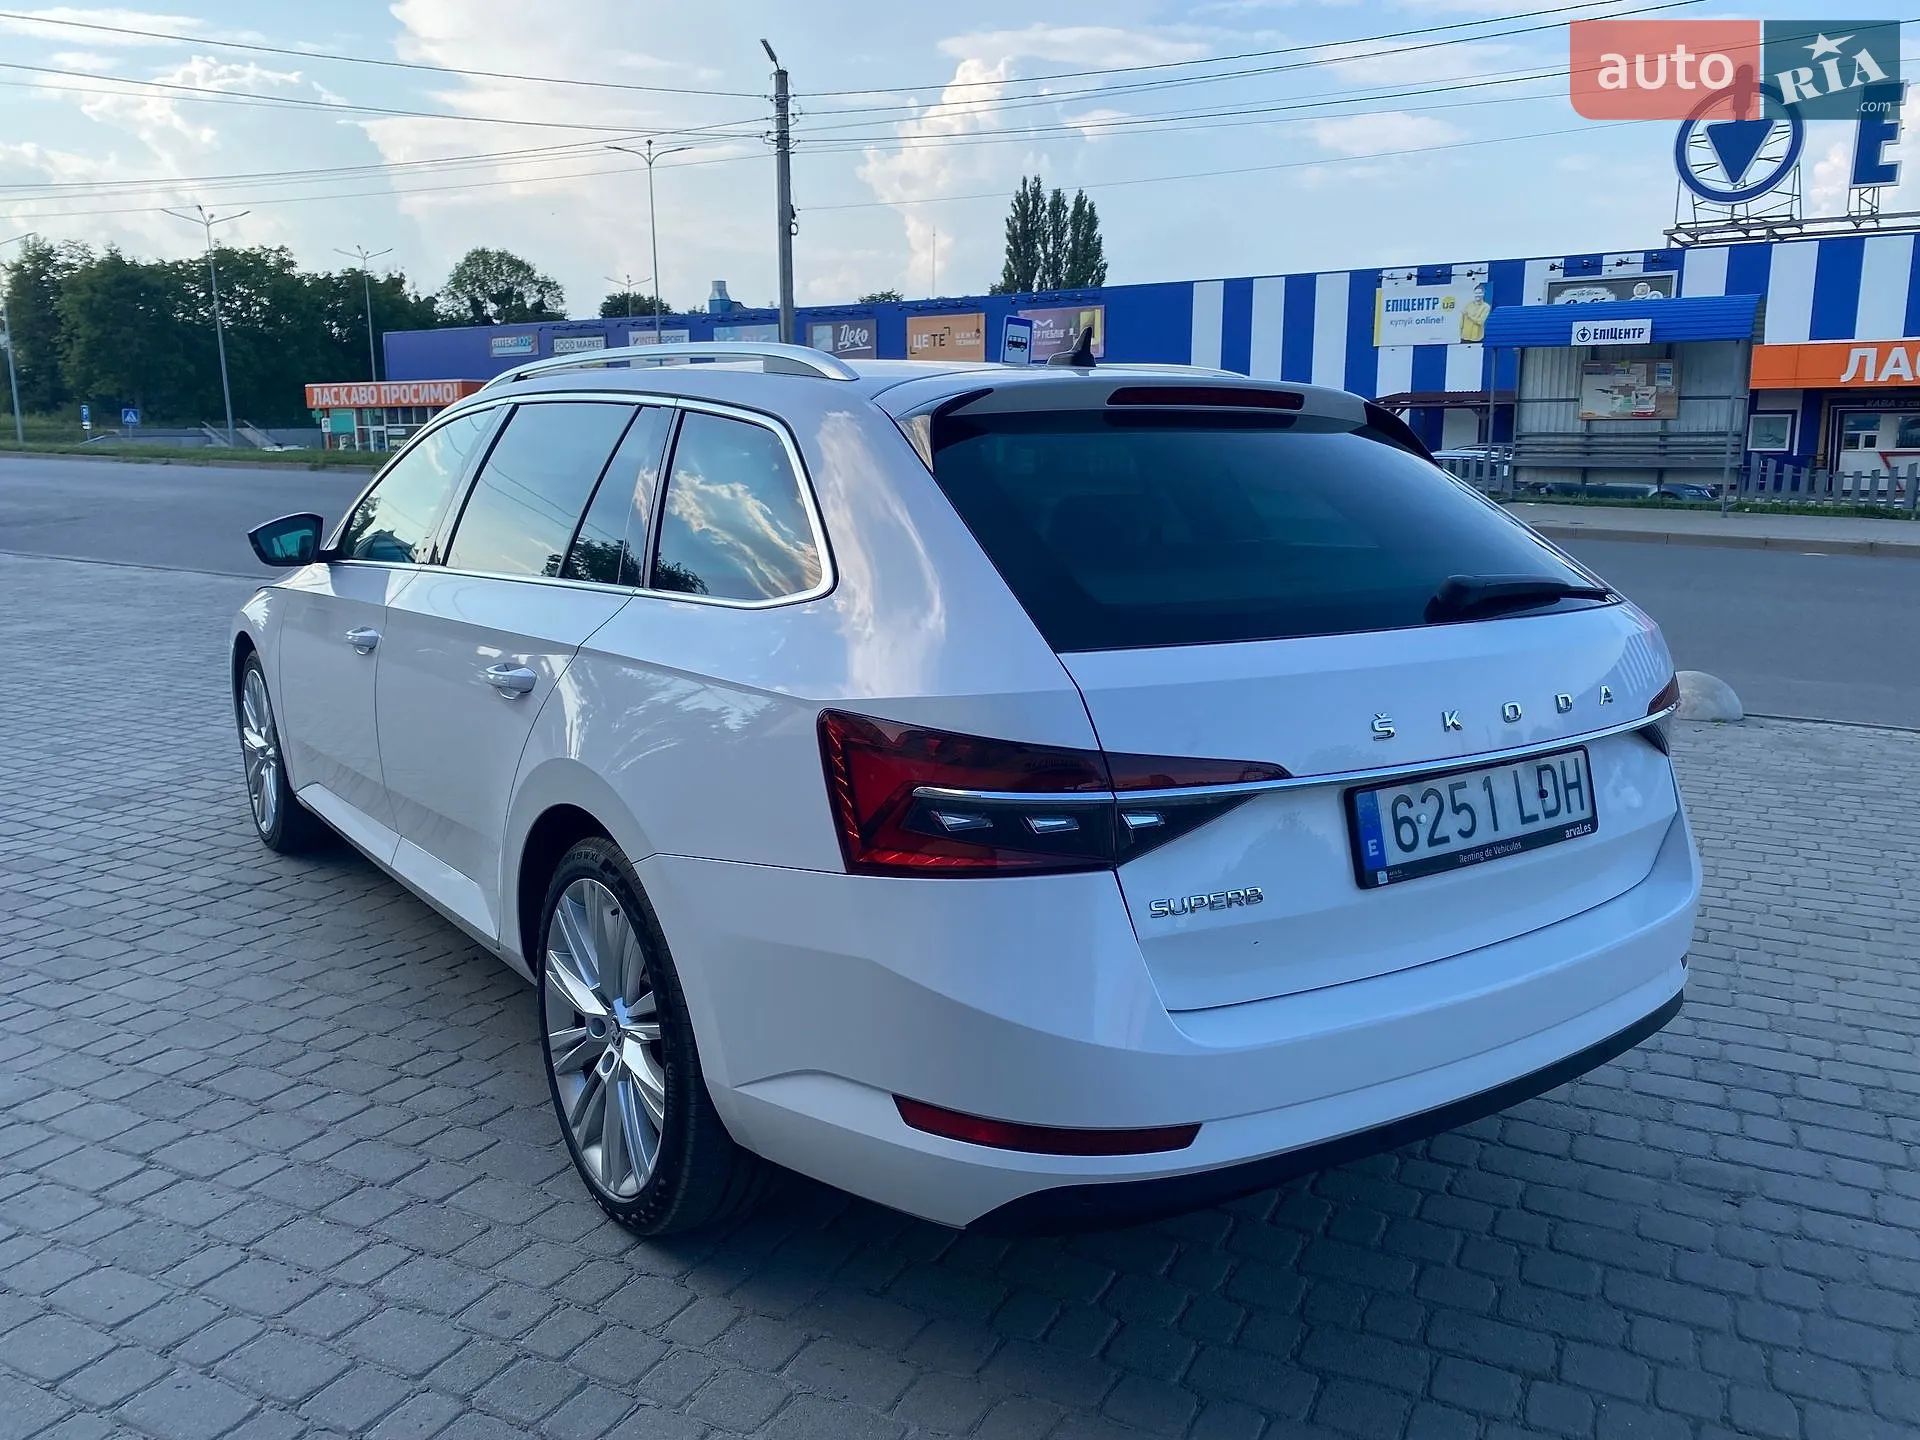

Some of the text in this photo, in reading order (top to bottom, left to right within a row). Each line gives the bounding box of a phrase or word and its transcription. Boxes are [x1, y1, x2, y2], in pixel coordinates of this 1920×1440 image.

[1385, 297, 1440, 313] ЕПІЦЕНТР
[838, 324, 870, 349] Деко
[1593, 327, 1645, 340] ЕПІЦЕНТР
[313, 383, 458, 405] ЛАСКАВО ПРОСИМО!
[1371, 684, 1614, 741] ŠKODA
[1391, 757, 1585, 853] 6251 LDH
[1367, 838, 1379, 856] E
[1459, 849, 1484, 863] Renting
[1485, 846, 1494, 857] de
[1149, 886, 1264, 918] SUPERB
